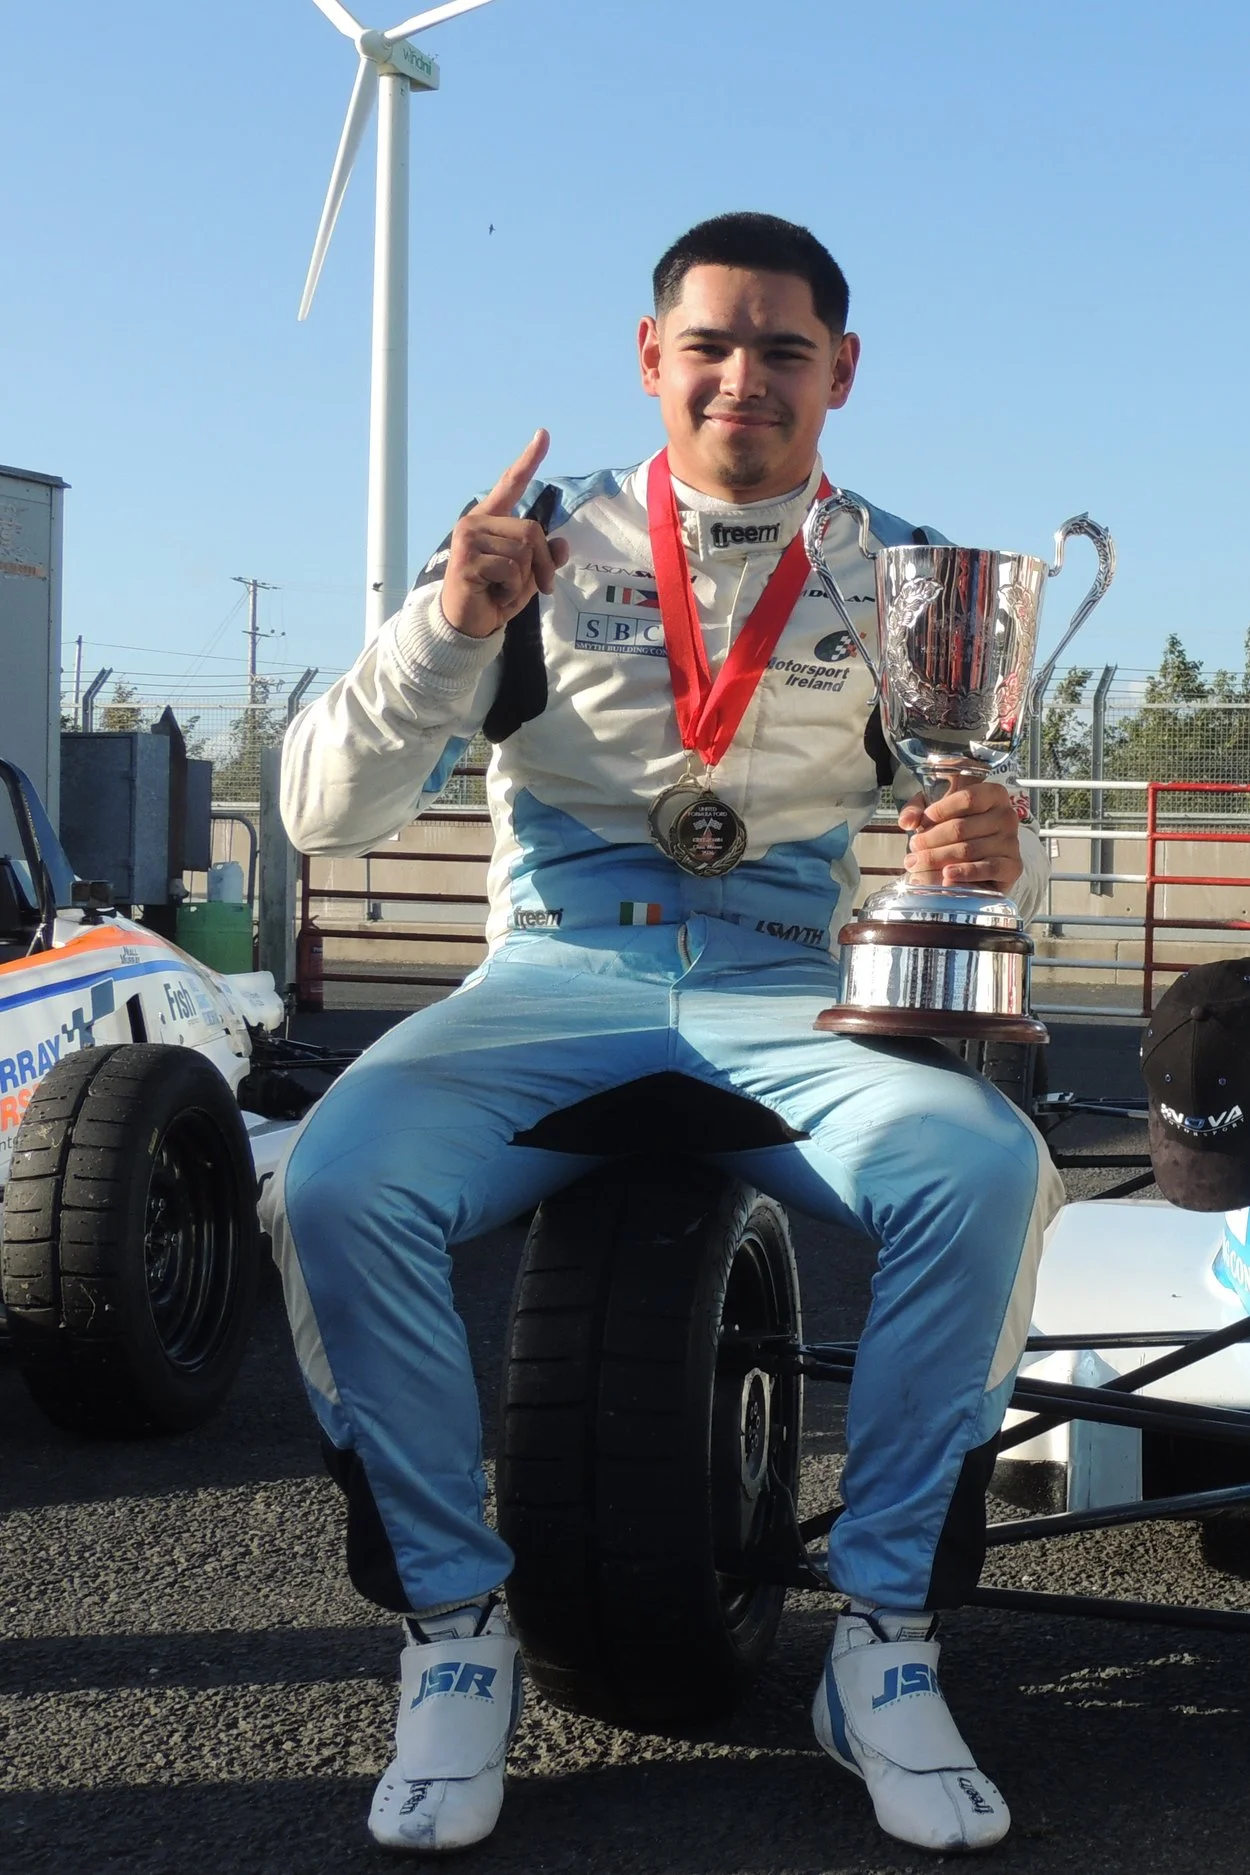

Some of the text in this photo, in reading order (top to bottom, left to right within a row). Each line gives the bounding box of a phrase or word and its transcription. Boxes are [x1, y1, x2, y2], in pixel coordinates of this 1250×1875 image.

[711, 522, 780, 548] freem
[785, 673, 845, 693] Ireland
[514, 907, 564, 928] freem
[410, 1661, 499, 1710] JSR
